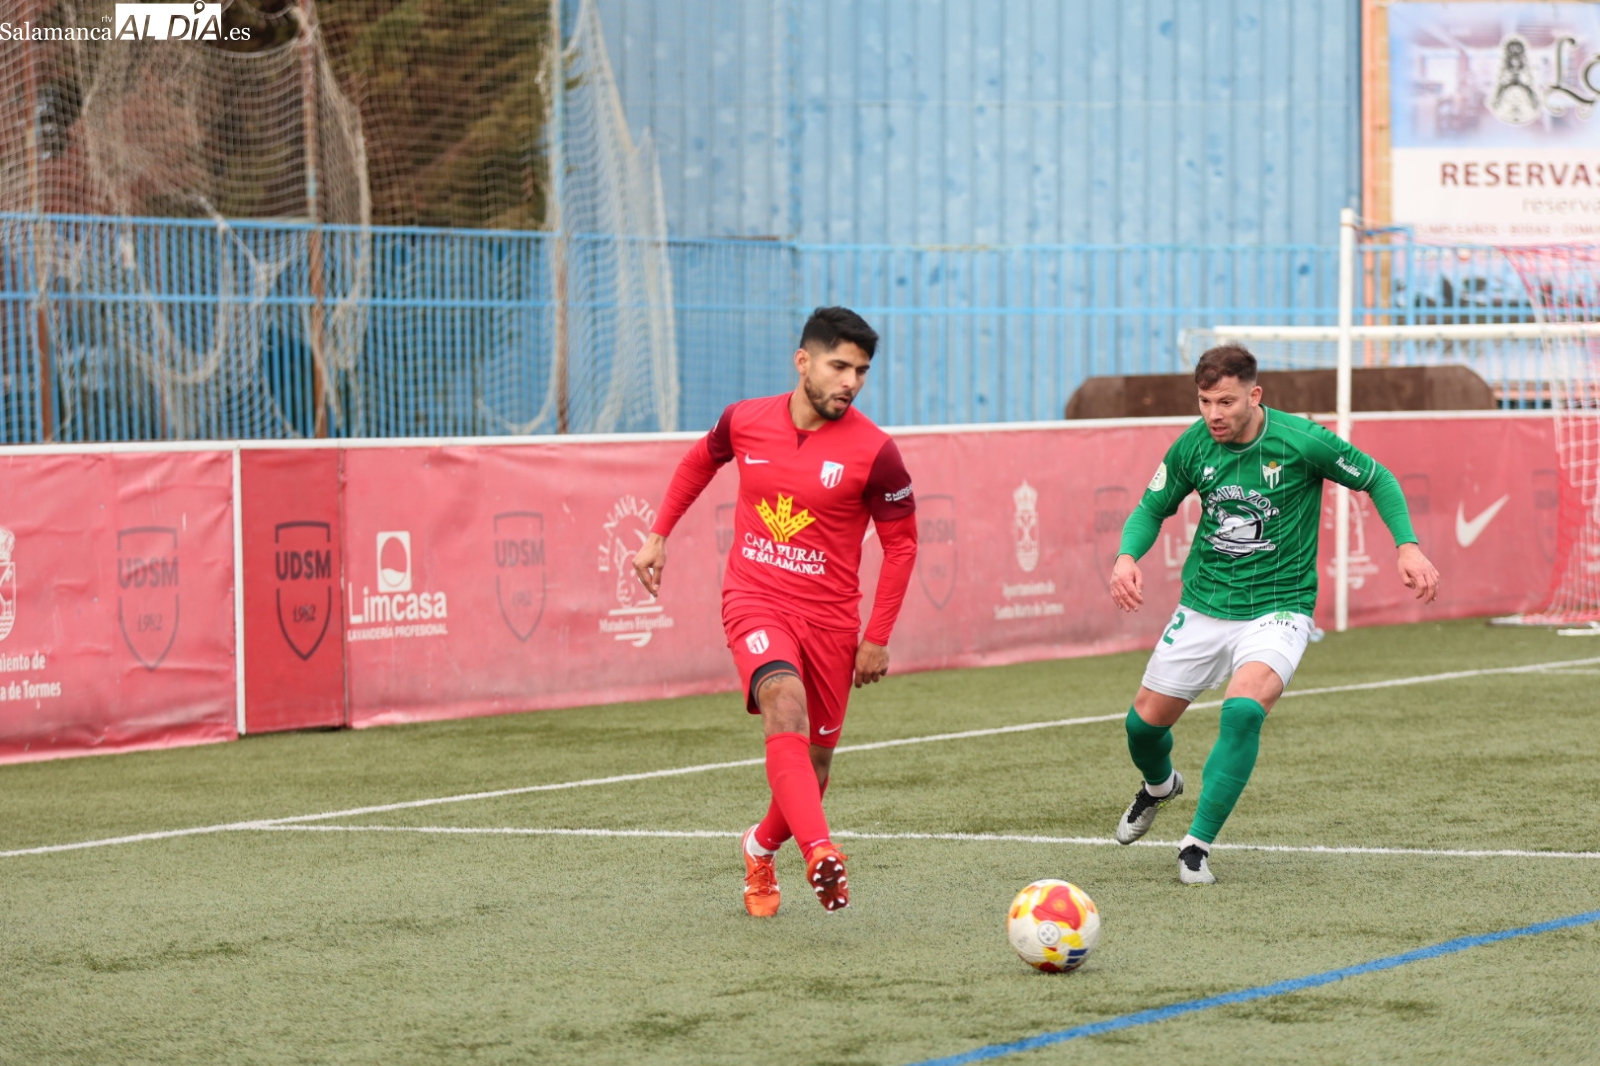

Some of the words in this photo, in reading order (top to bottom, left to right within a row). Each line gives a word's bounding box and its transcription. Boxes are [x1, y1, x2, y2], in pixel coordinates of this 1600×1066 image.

[494, 538, 545, 568] UDSM
[742, 547, 756, 560] DE
[756, 552, 825, 575] SALAMANCA
[745, 532, 774, 554] CAJA
[776, 544, 827, 563] RURAL
[117, 556, 179, 589] UDSM
[275, 550, 331, 581] UDSM
[348, 581, 447, 624] Limcasa
[1163, 611, 1185, 645] 2
[31, 650, 46, 671] de
[8, 680, 22, 701] de
[22, 679, 62, 699] Tormes
